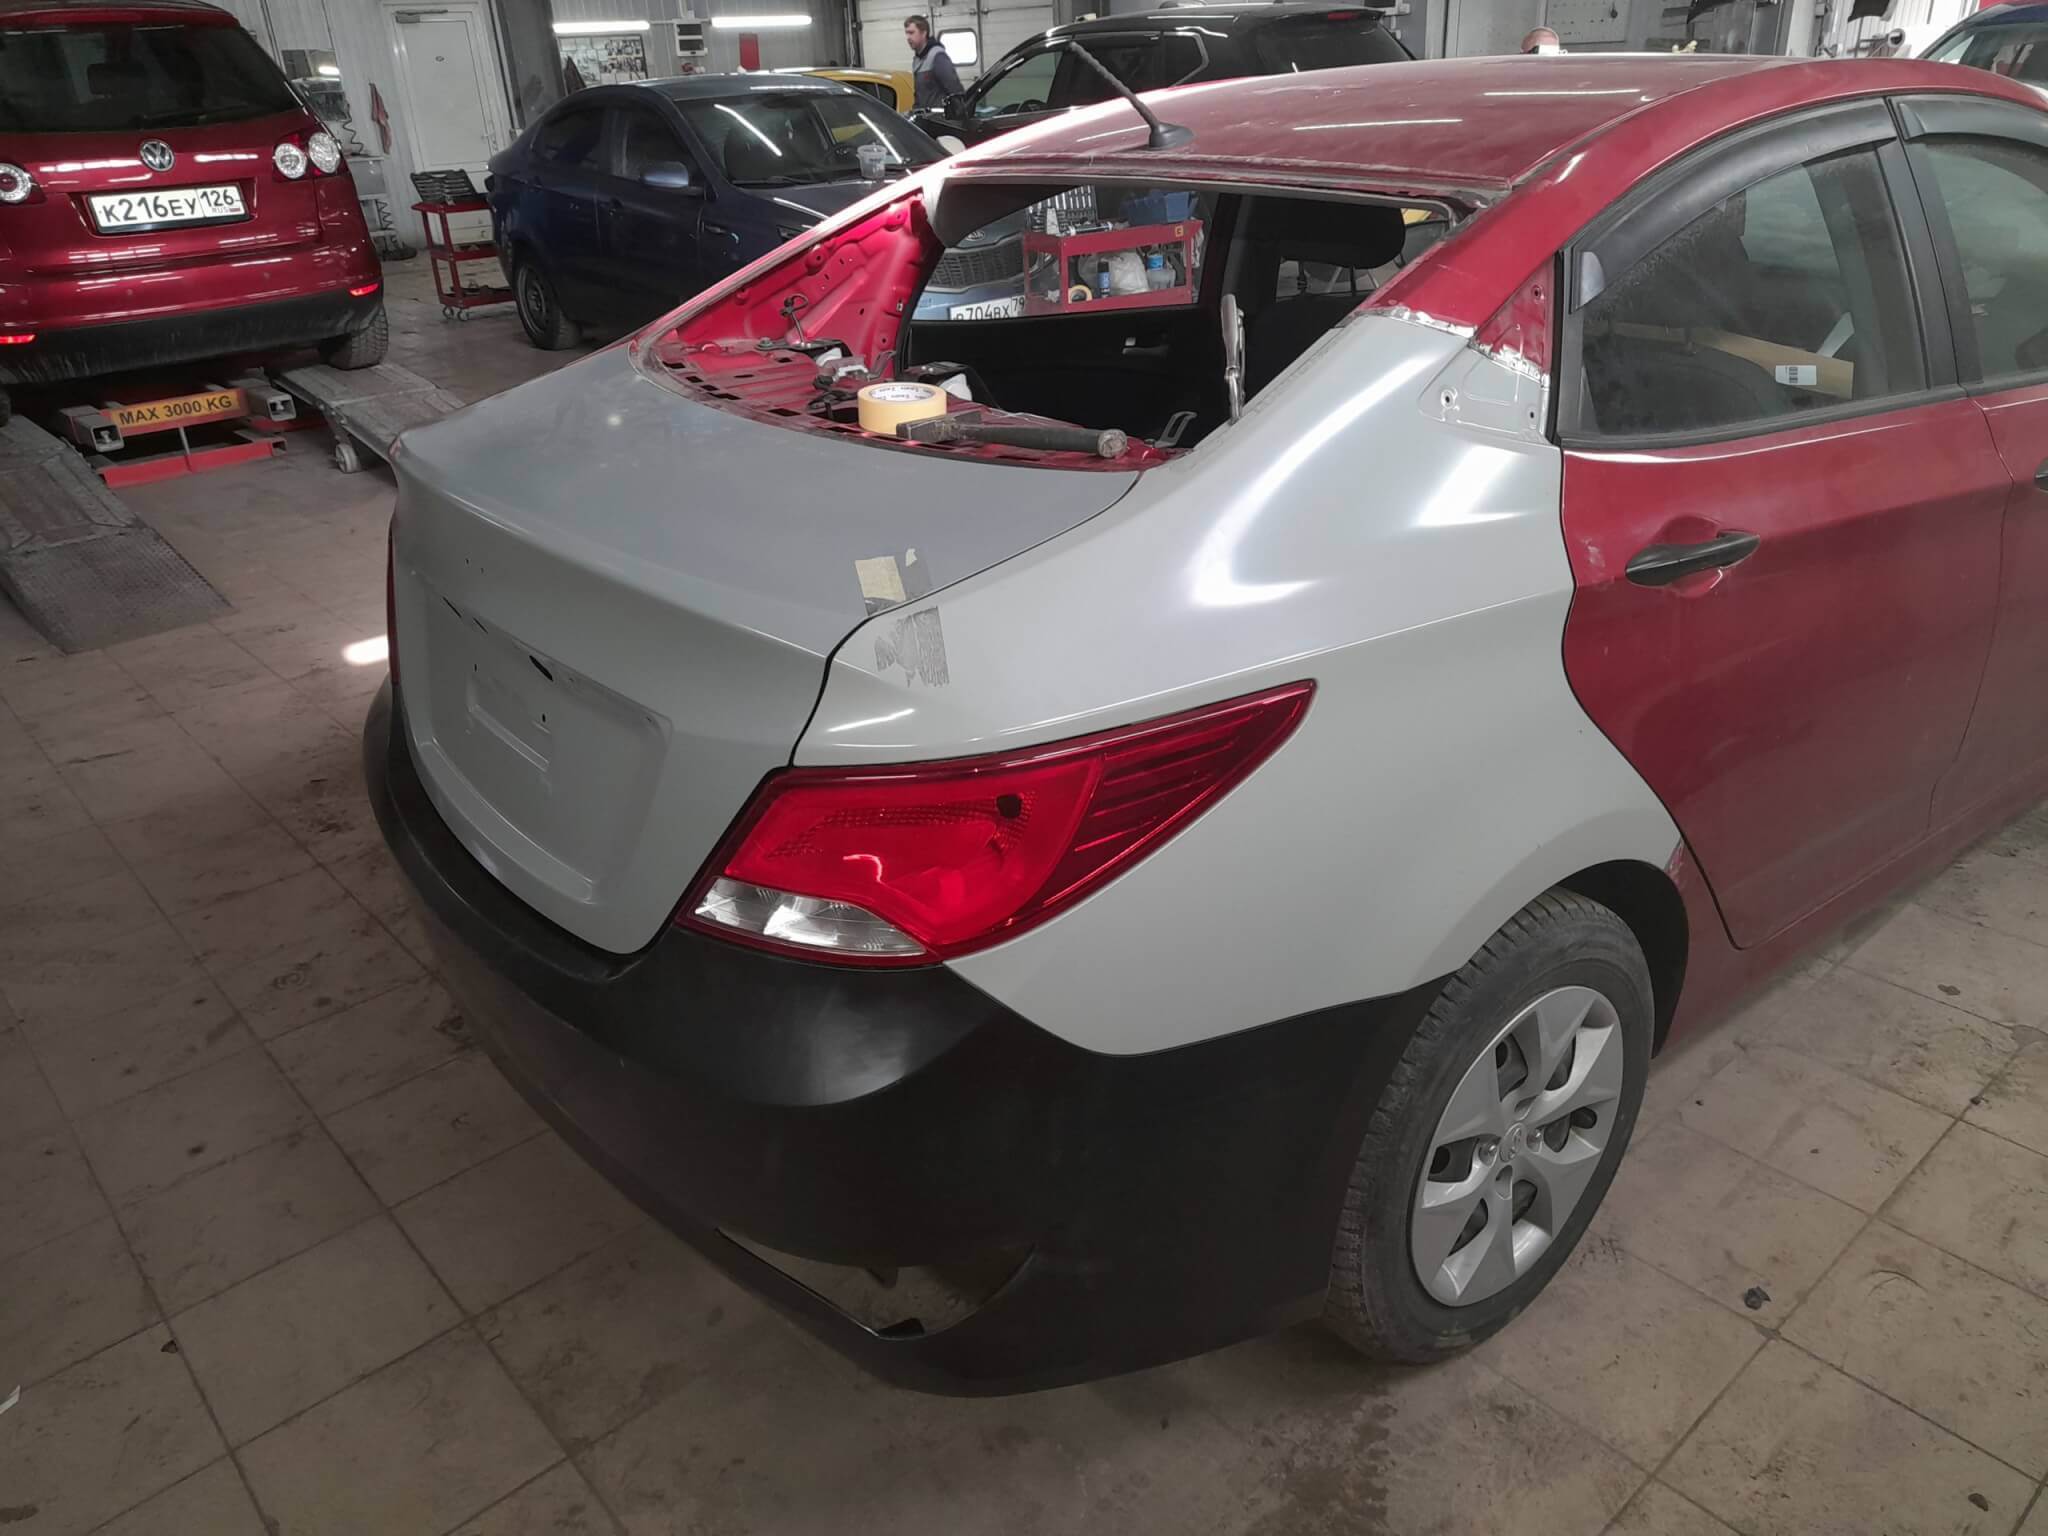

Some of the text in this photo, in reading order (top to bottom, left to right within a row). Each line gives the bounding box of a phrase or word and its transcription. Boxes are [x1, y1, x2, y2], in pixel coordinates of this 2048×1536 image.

[200, 189, 234, 207] 126
[119, 395, 232, 425] MAX 3000 KG
